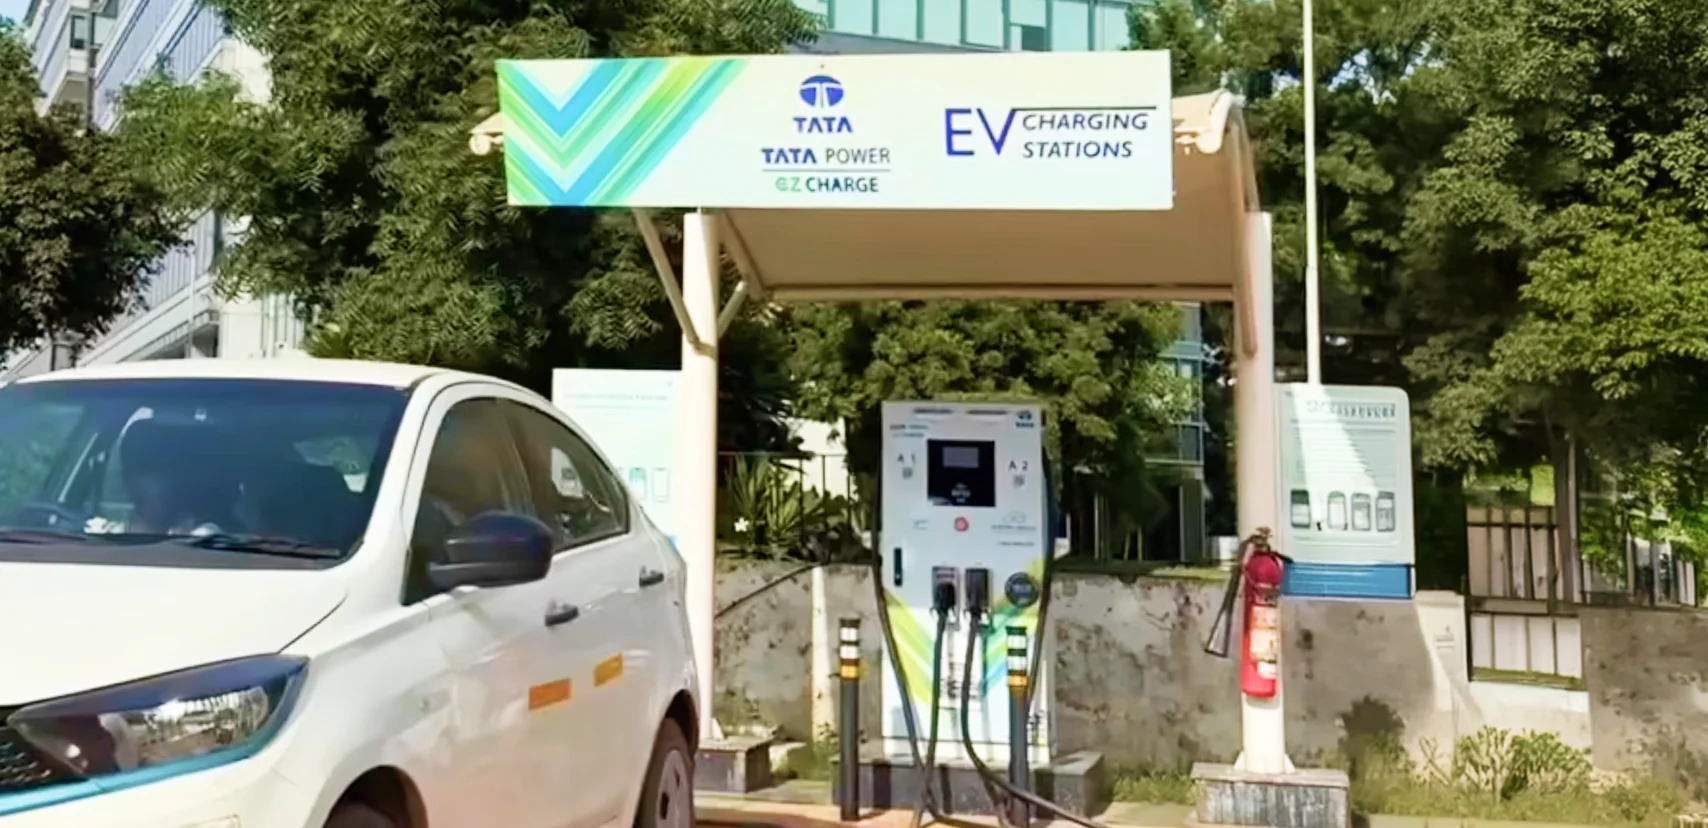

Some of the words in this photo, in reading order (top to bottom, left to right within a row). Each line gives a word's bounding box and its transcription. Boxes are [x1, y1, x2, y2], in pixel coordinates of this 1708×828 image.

[793, 116, 853, 133] TATA
[1022, 113, 1149, 131] CHARGING
[945, 108, 1016, 156] EV
[761, 148, 817, 164] TATA
[825, 148, 891, 164] POWER
[1023, 140, 1133, 159] STATIONS
[805, 177, 879, 192] CHARGE
